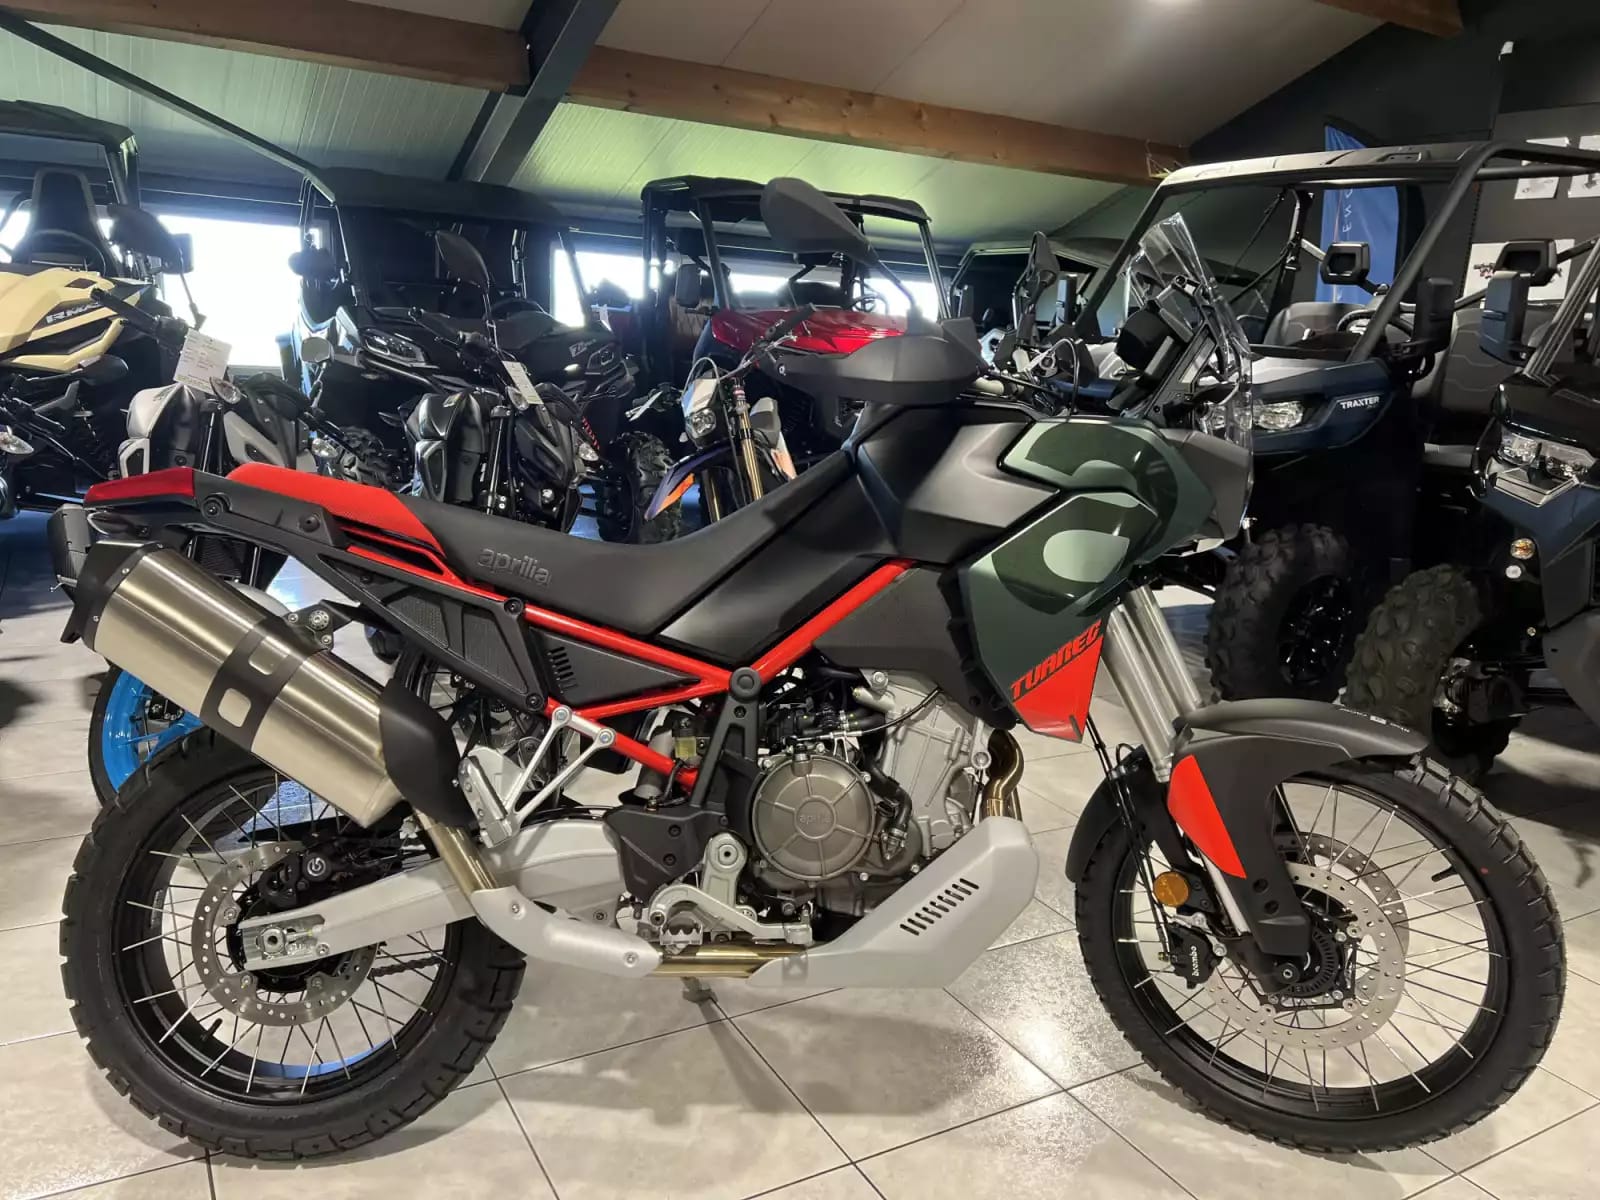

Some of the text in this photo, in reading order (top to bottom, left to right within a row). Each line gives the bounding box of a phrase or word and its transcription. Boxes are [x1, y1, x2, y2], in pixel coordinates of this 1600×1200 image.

[1340, 396, 1379, 409] TRAXTER
[477, 548, 552, 585] aprilia
[1010, 619, 1101, 701] TUAREG
[1189, 945, 1200, 977] brembo
